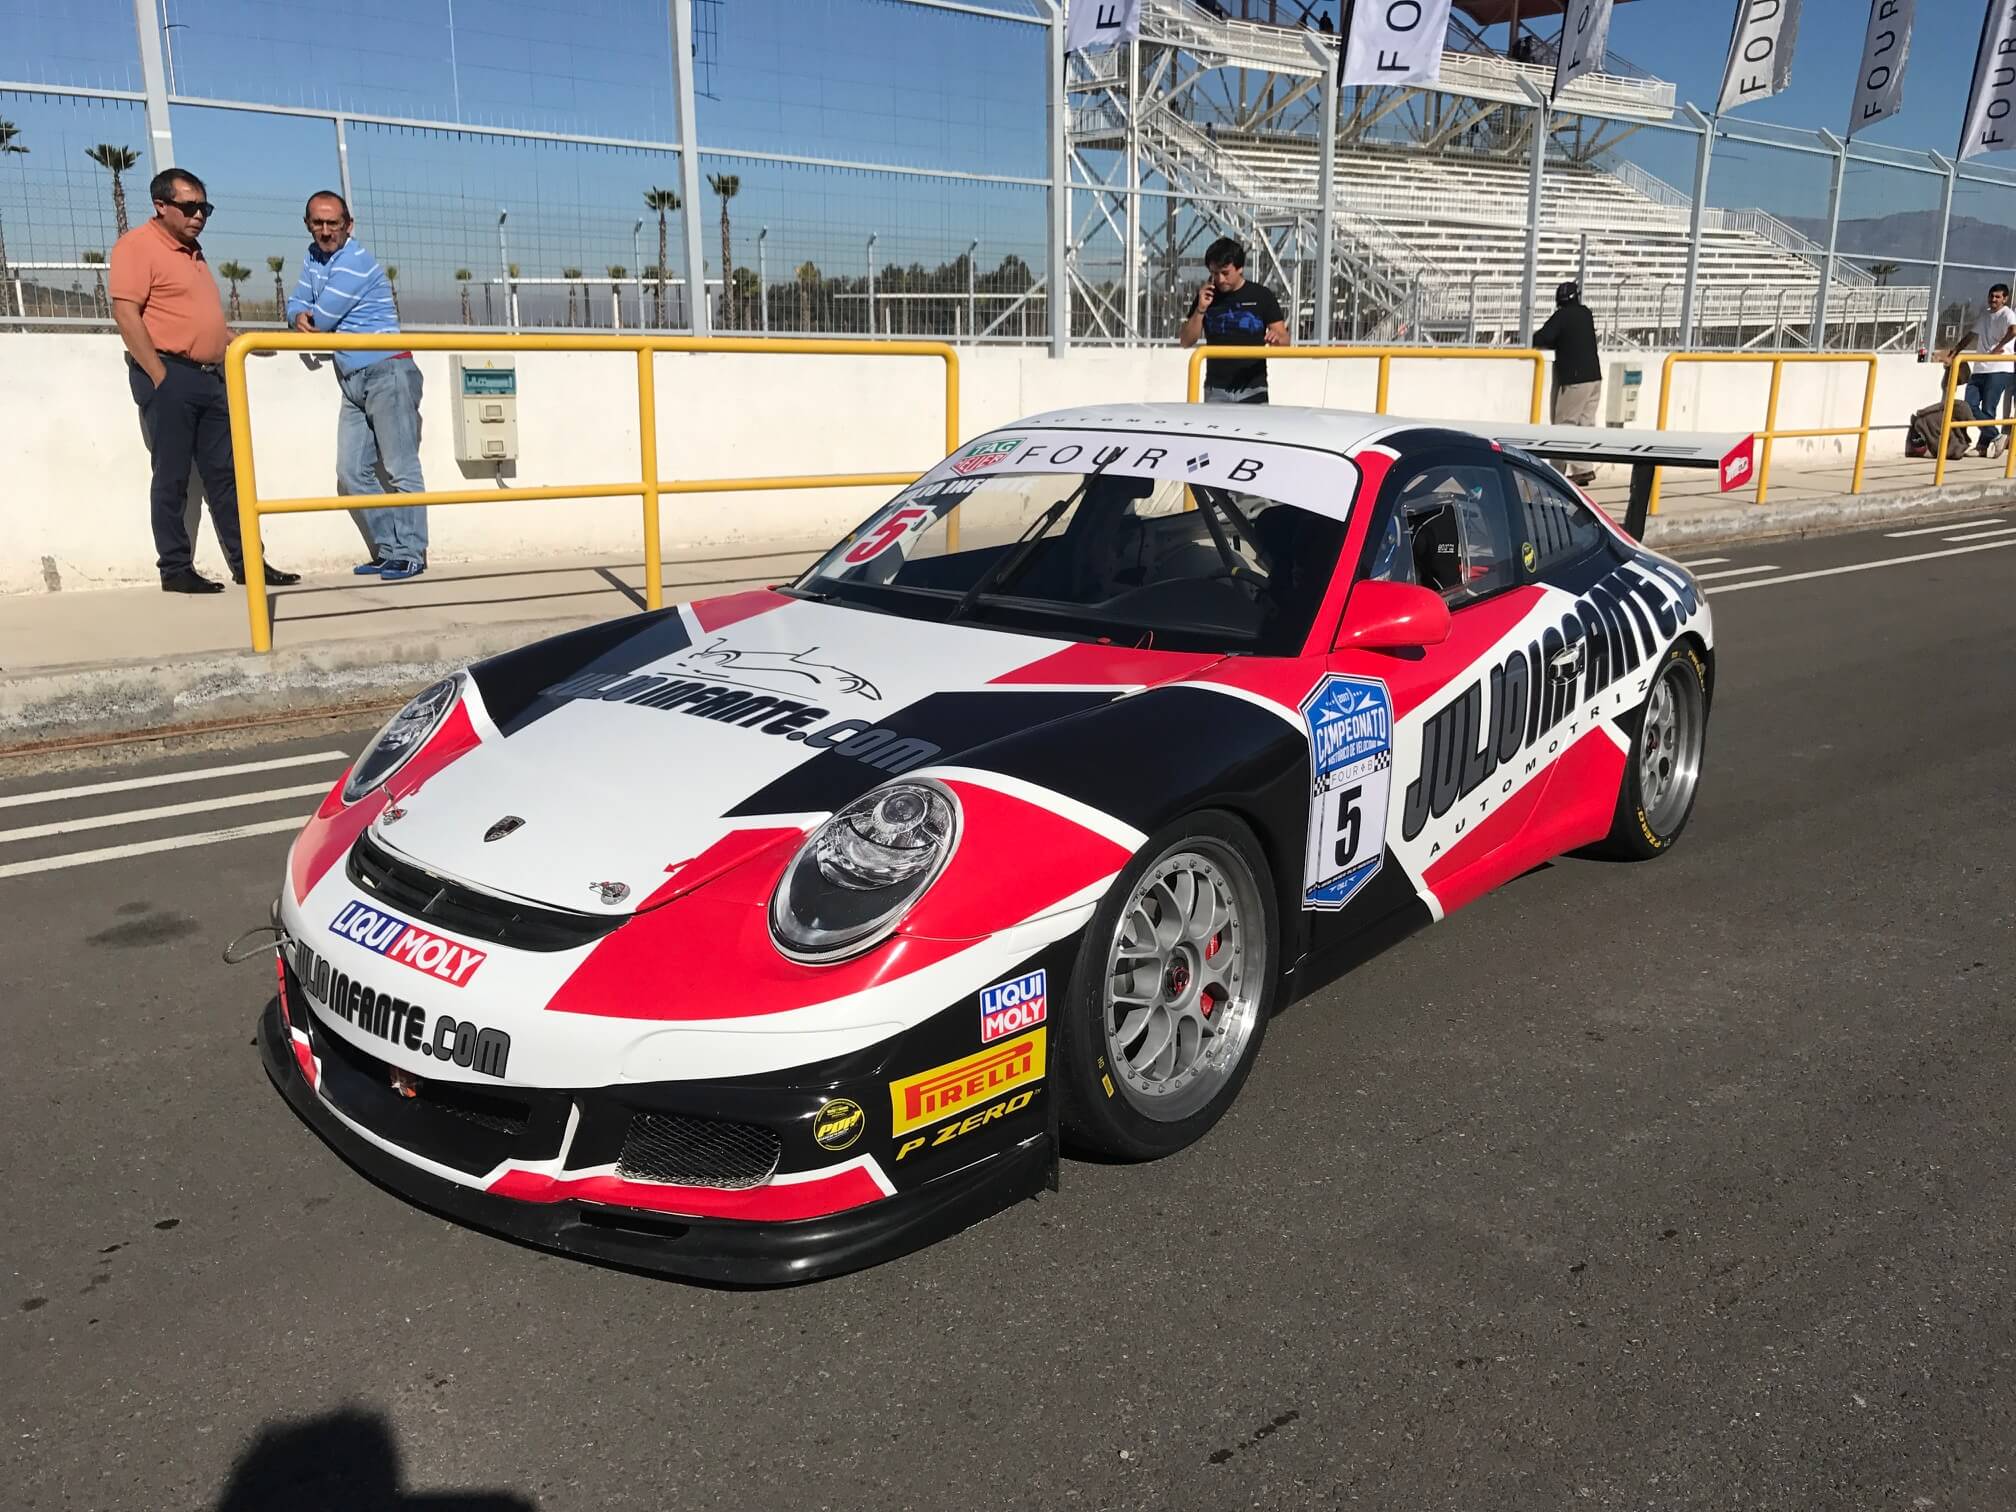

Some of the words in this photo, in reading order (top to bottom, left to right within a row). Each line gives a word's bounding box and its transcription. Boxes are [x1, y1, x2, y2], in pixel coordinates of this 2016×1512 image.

[1863, 0, 1899, 119] FOUR
[1981, 38, 2016, 145] FOUR
[971, 440, 1017, 456] TAG
[1015, 444, 1168, 470] FOUR
[1226, 458, 1264, 482] B
[843, 508, 930, 564] 5
[1316, 706, 1386, 764] CAMPEONATO
[1331, 765, 1359, 785] FOUR
[1429, 679, 1648, 858] AUTOMOTRIZ
[1335, 784, 1362, 867] 5
[332, 903, 404, 951] LIQUI
[391, 928, 484, 983] MOLY
[984, 974, 1043, 1015] LIQUI
[986, 1000, 1044, 1039] MOLY
[904, 1041, 1034, 1121] PIRELLI
[895, 1136, 926, 1161] P
